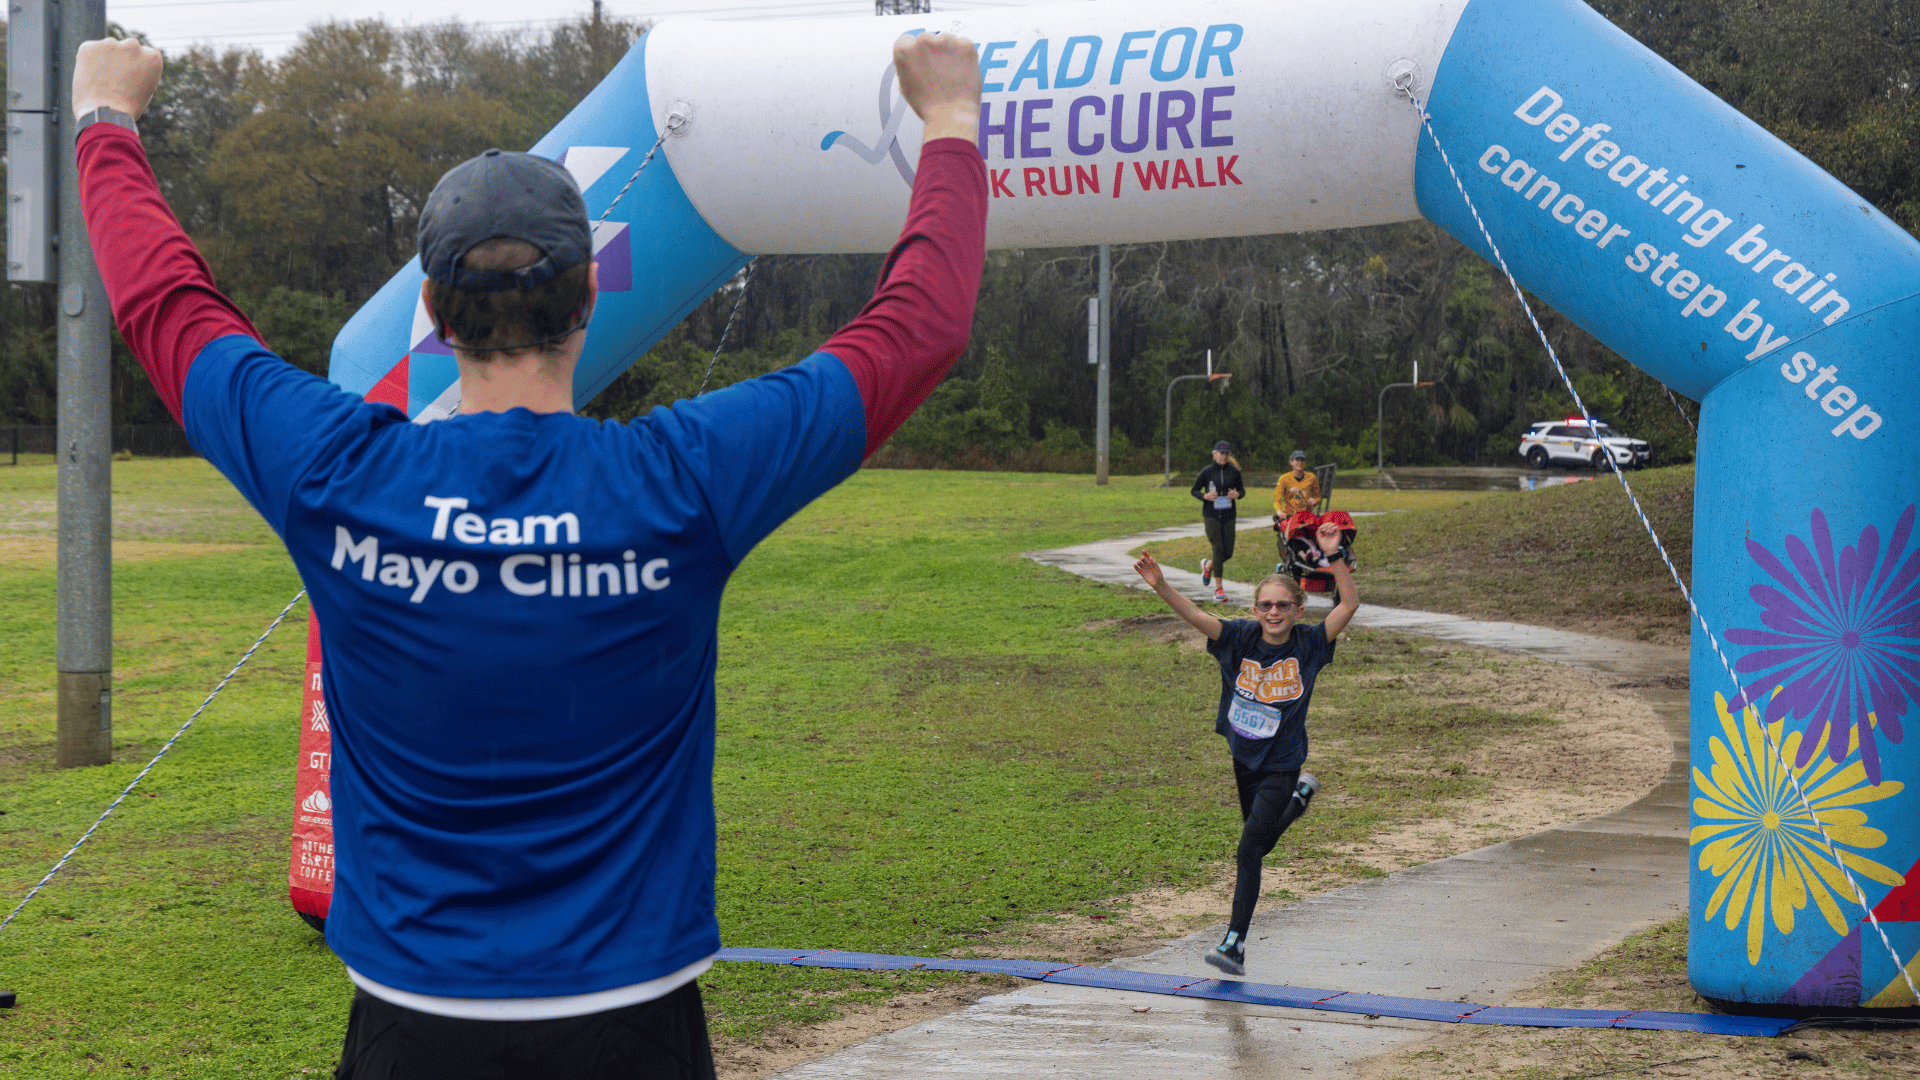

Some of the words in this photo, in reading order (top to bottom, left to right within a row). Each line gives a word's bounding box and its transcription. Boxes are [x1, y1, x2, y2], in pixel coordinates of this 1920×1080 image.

[973, 35, 1103, 93] EAD
[1110, 23, 1244, 86] FOR
[978, 98, 1054, 160] HE
[1068, 86, 1236, 156] CURE
[990, 168, 1016, 198] K
[1023, 164, 1102, 197] RUN
[1133, 155, 1244, 191] WALK
[1514, 85, 1733, 248] Defeating
[1726, 223, 1851, 326] brain
[1477, 144, 1631, 249] cancer
[1625, 241, 1728, 318] step
[1724, 298, 1791, 362] by
[1780, 350, 1883, 440] step
[424, 496, 580, 545] Team
[331, 525, 479, 604] Mayo
[500, 549, 671, 597] Clinic
[1258, 681, 1299, 698] Cure
[300, 866, 332, 882] COFFE
